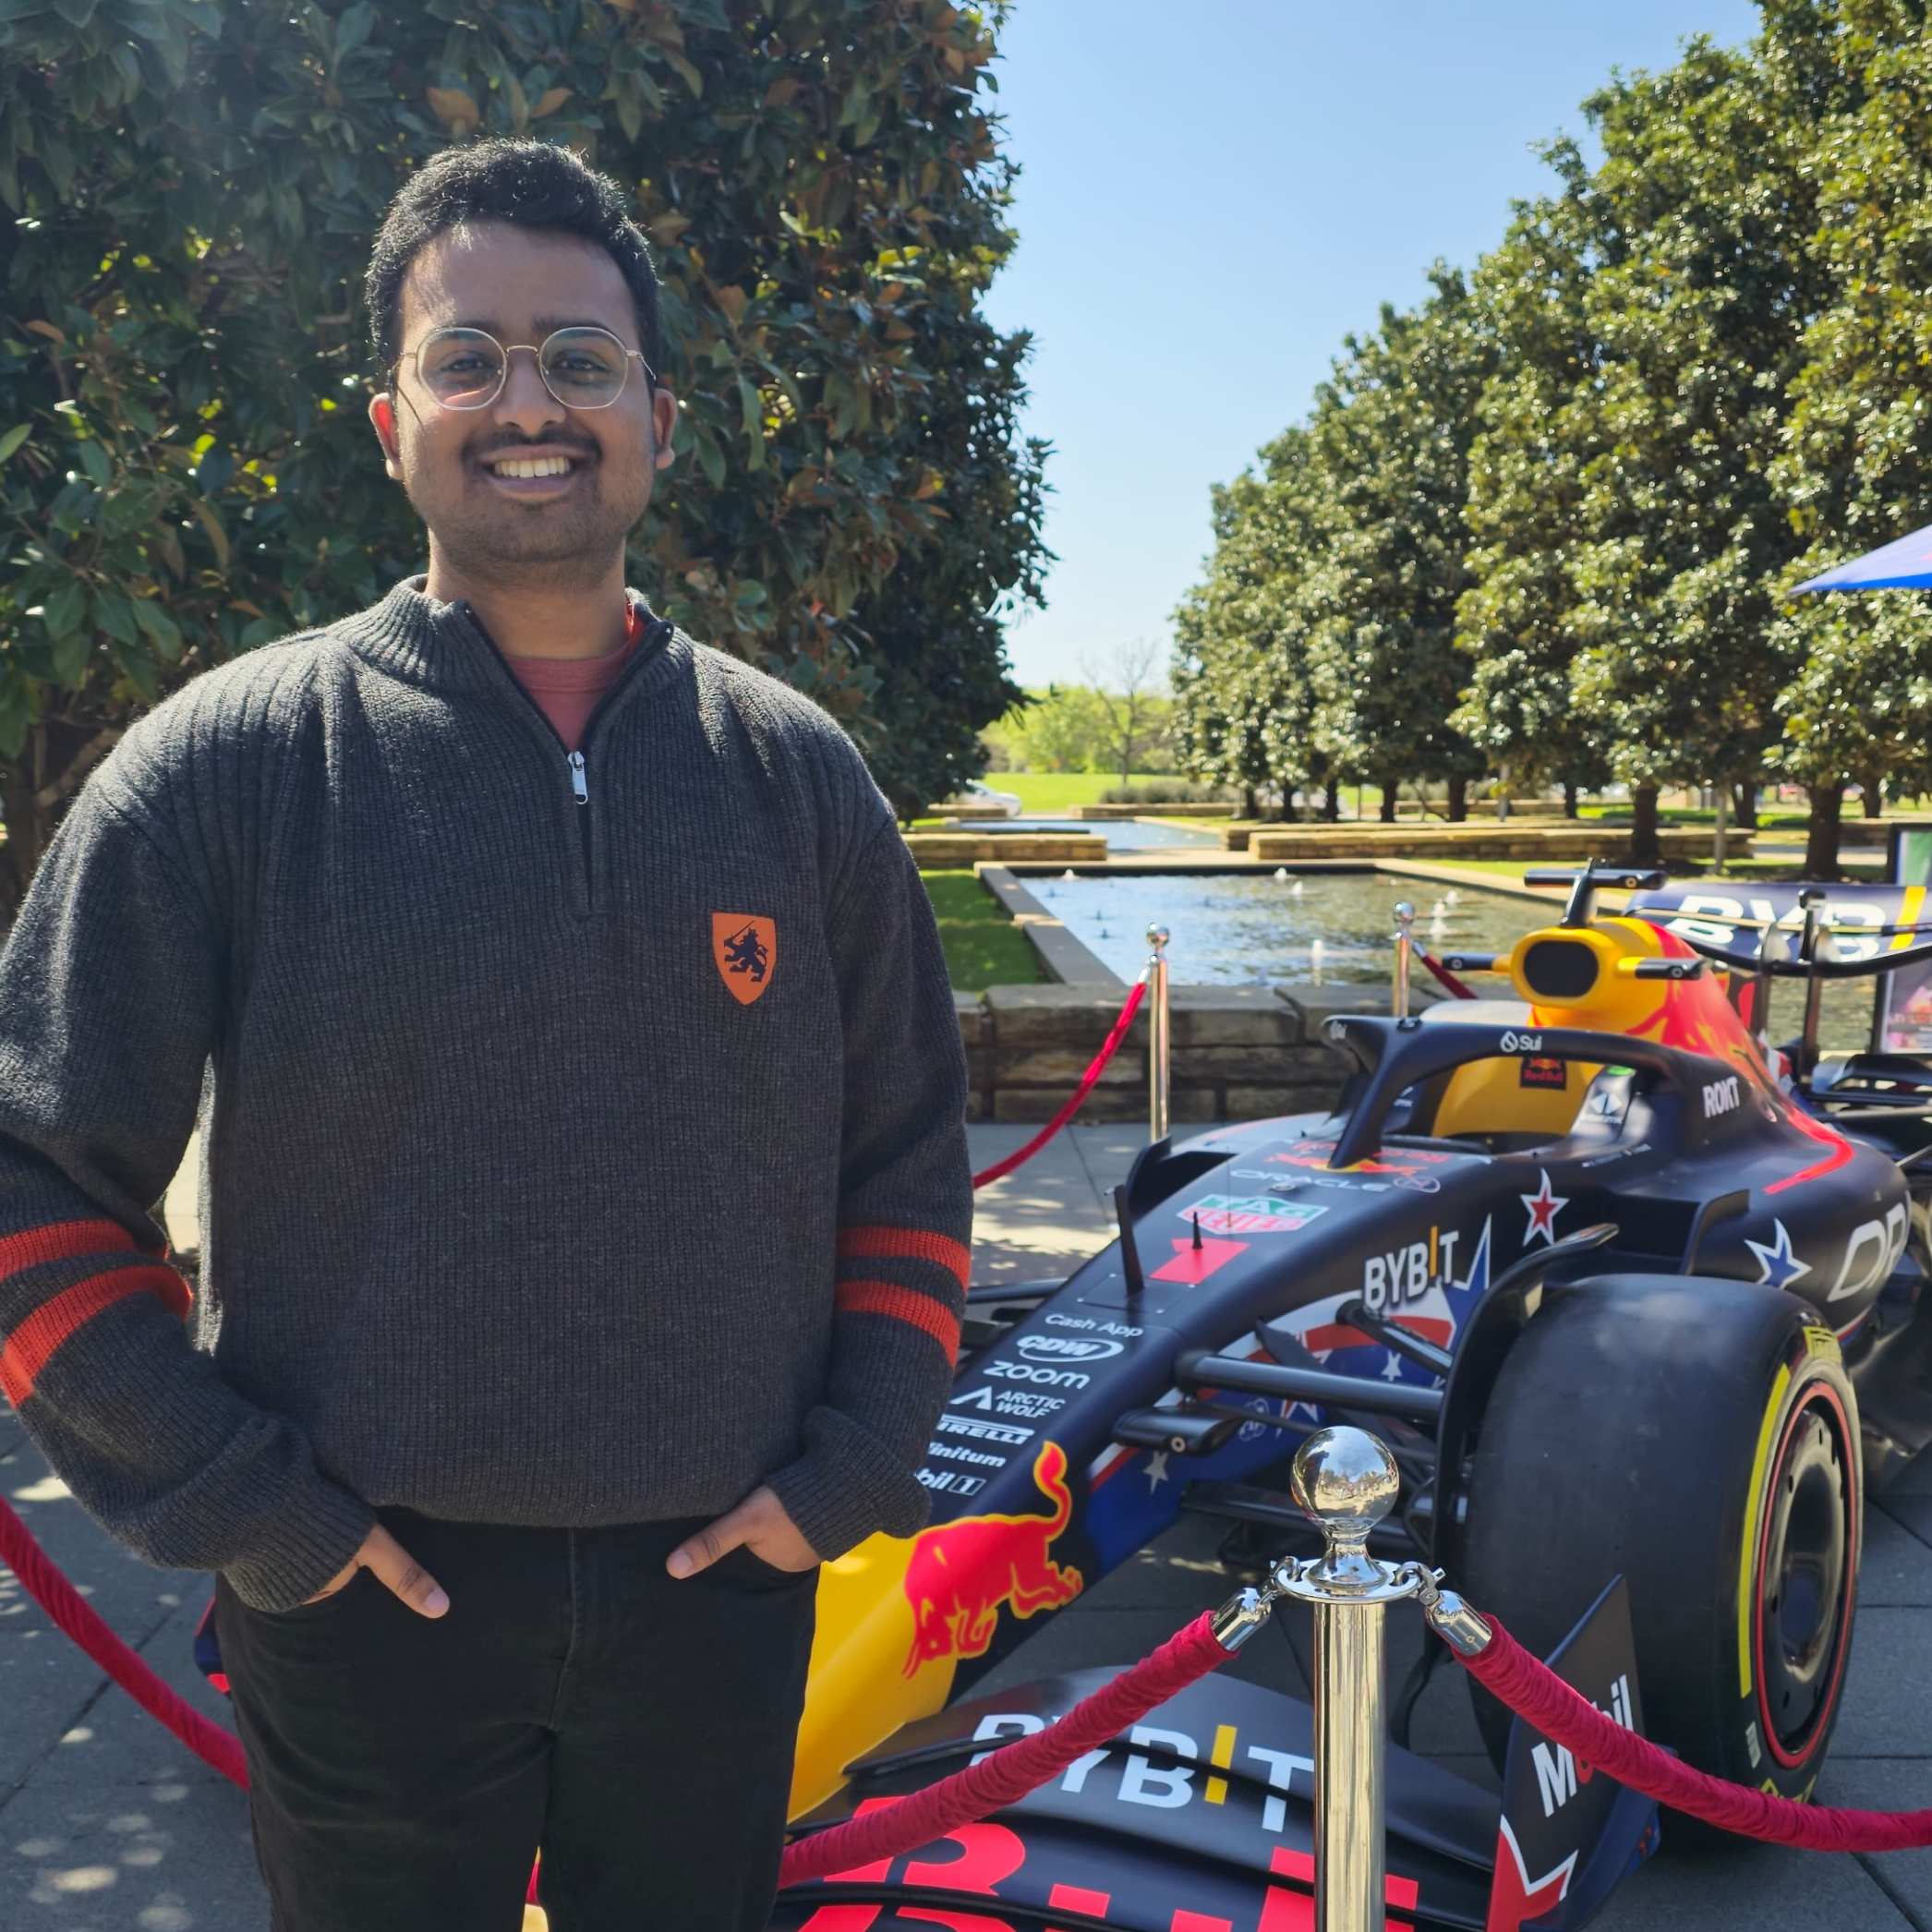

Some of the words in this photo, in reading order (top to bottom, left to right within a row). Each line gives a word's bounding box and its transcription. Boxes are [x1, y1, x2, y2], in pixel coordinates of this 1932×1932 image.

[1519, 1035, 1542, 1051] Sui
[1525, 1069, 1545, 1081] Red
[1546, 1070, 1564, 1082] Bull
[1702, 1076, 1740, 1118] ROKT
[1231, 1169, 1392, 1192] ORACLE
[1212, 1195, 1318, 1219] TAG
[1363, 1226, 1460, 1310] BYBIT
[1044, 1313, 1097, 1331] Cash
[1097, 1322, 1144, 1337] App
[1017, 1335, 1102, 1357] CDW
[983, 1360, 1091, 1389] zoom
[996, 1391, 1067, 1409] ARCTIC
[996, 1401, 1051, 1419] WOLF
[936, 1414, 1034, 1445] IRELLI
[915, 1468, 956, 1491] bil
